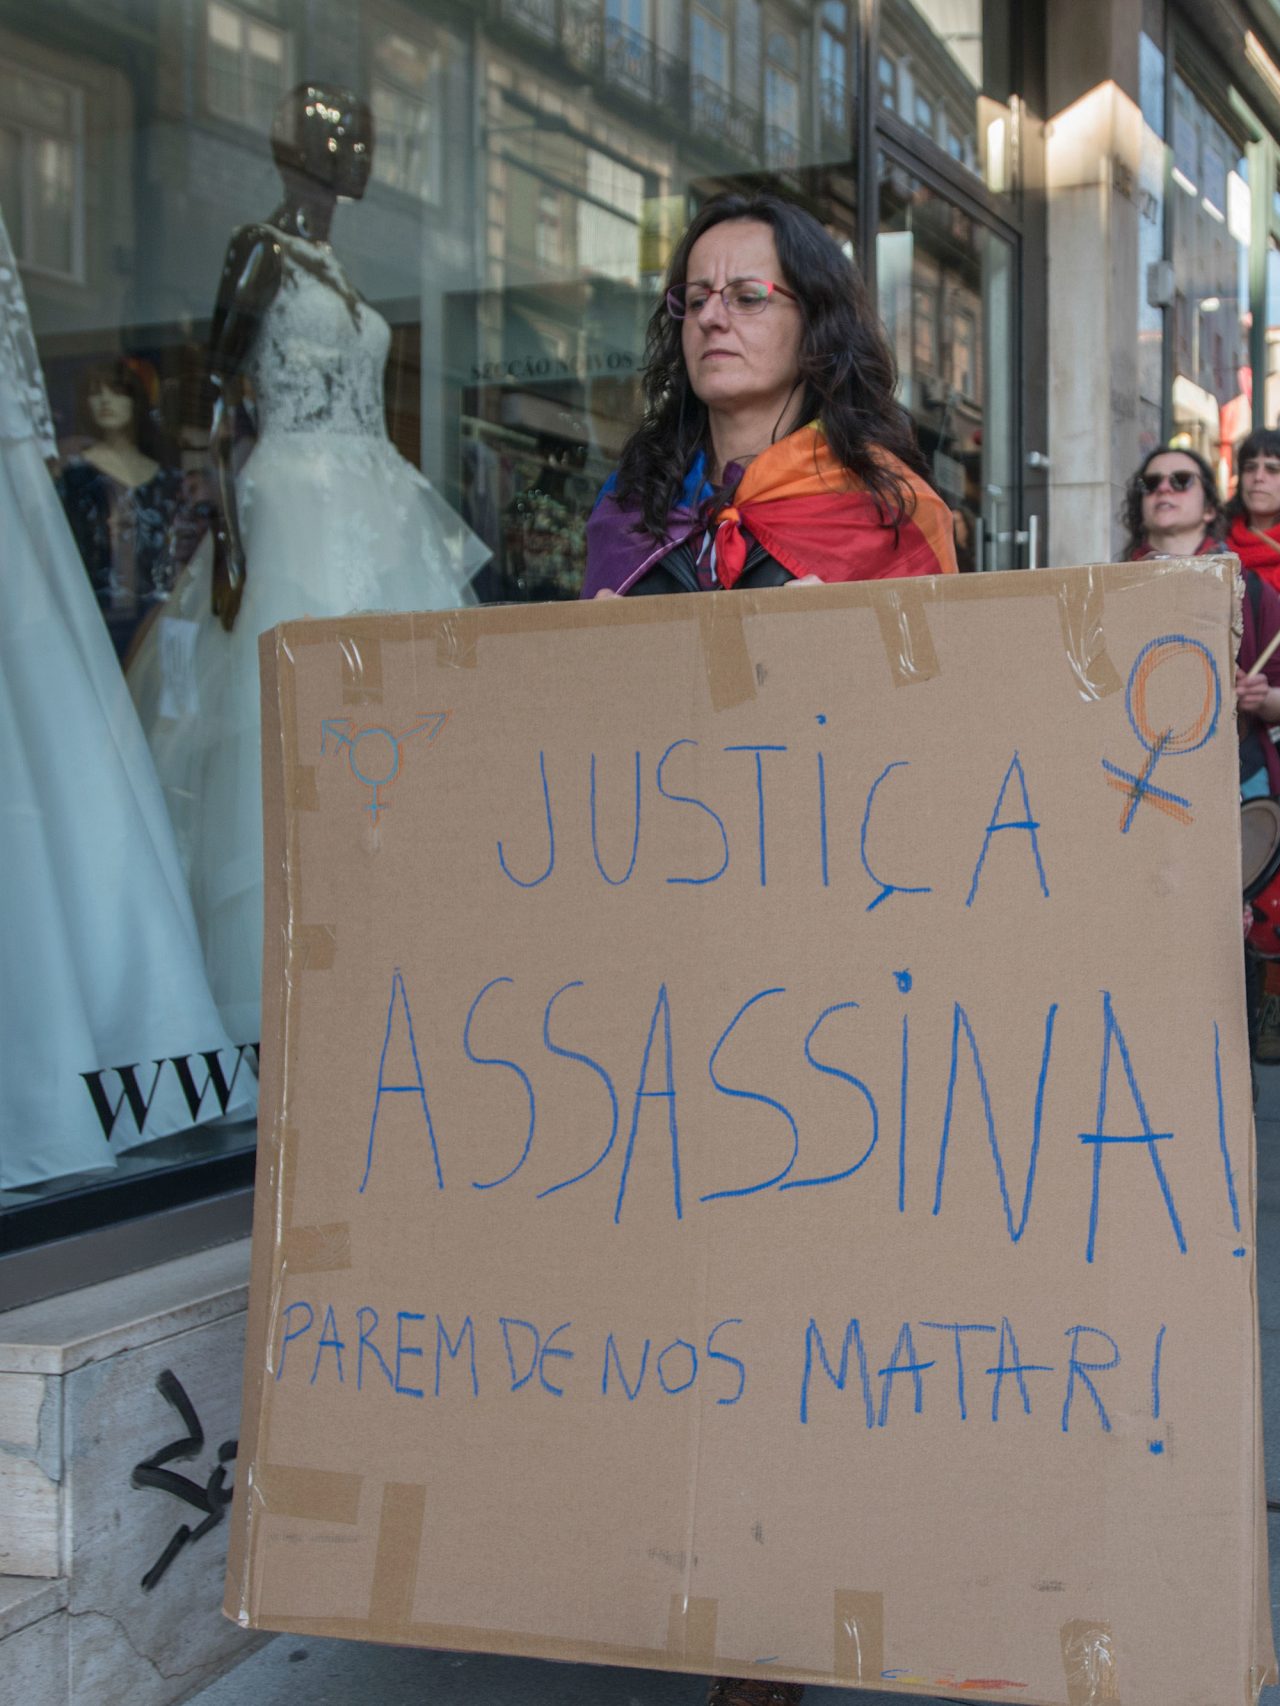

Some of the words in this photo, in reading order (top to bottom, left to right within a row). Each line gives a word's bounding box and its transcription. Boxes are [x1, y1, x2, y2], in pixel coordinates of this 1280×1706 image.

[497, 714, 1050, 912] JUSTIÇA
[359, 966, 1246, 1263] ASSASSINA!
[276, 1301, 479, 1398] PAREM
[498, 1319, 573, 1397] DE
[601, 1319, 746, 1405] NOS
[800, 1316, 1167, 1455] MATAR!
